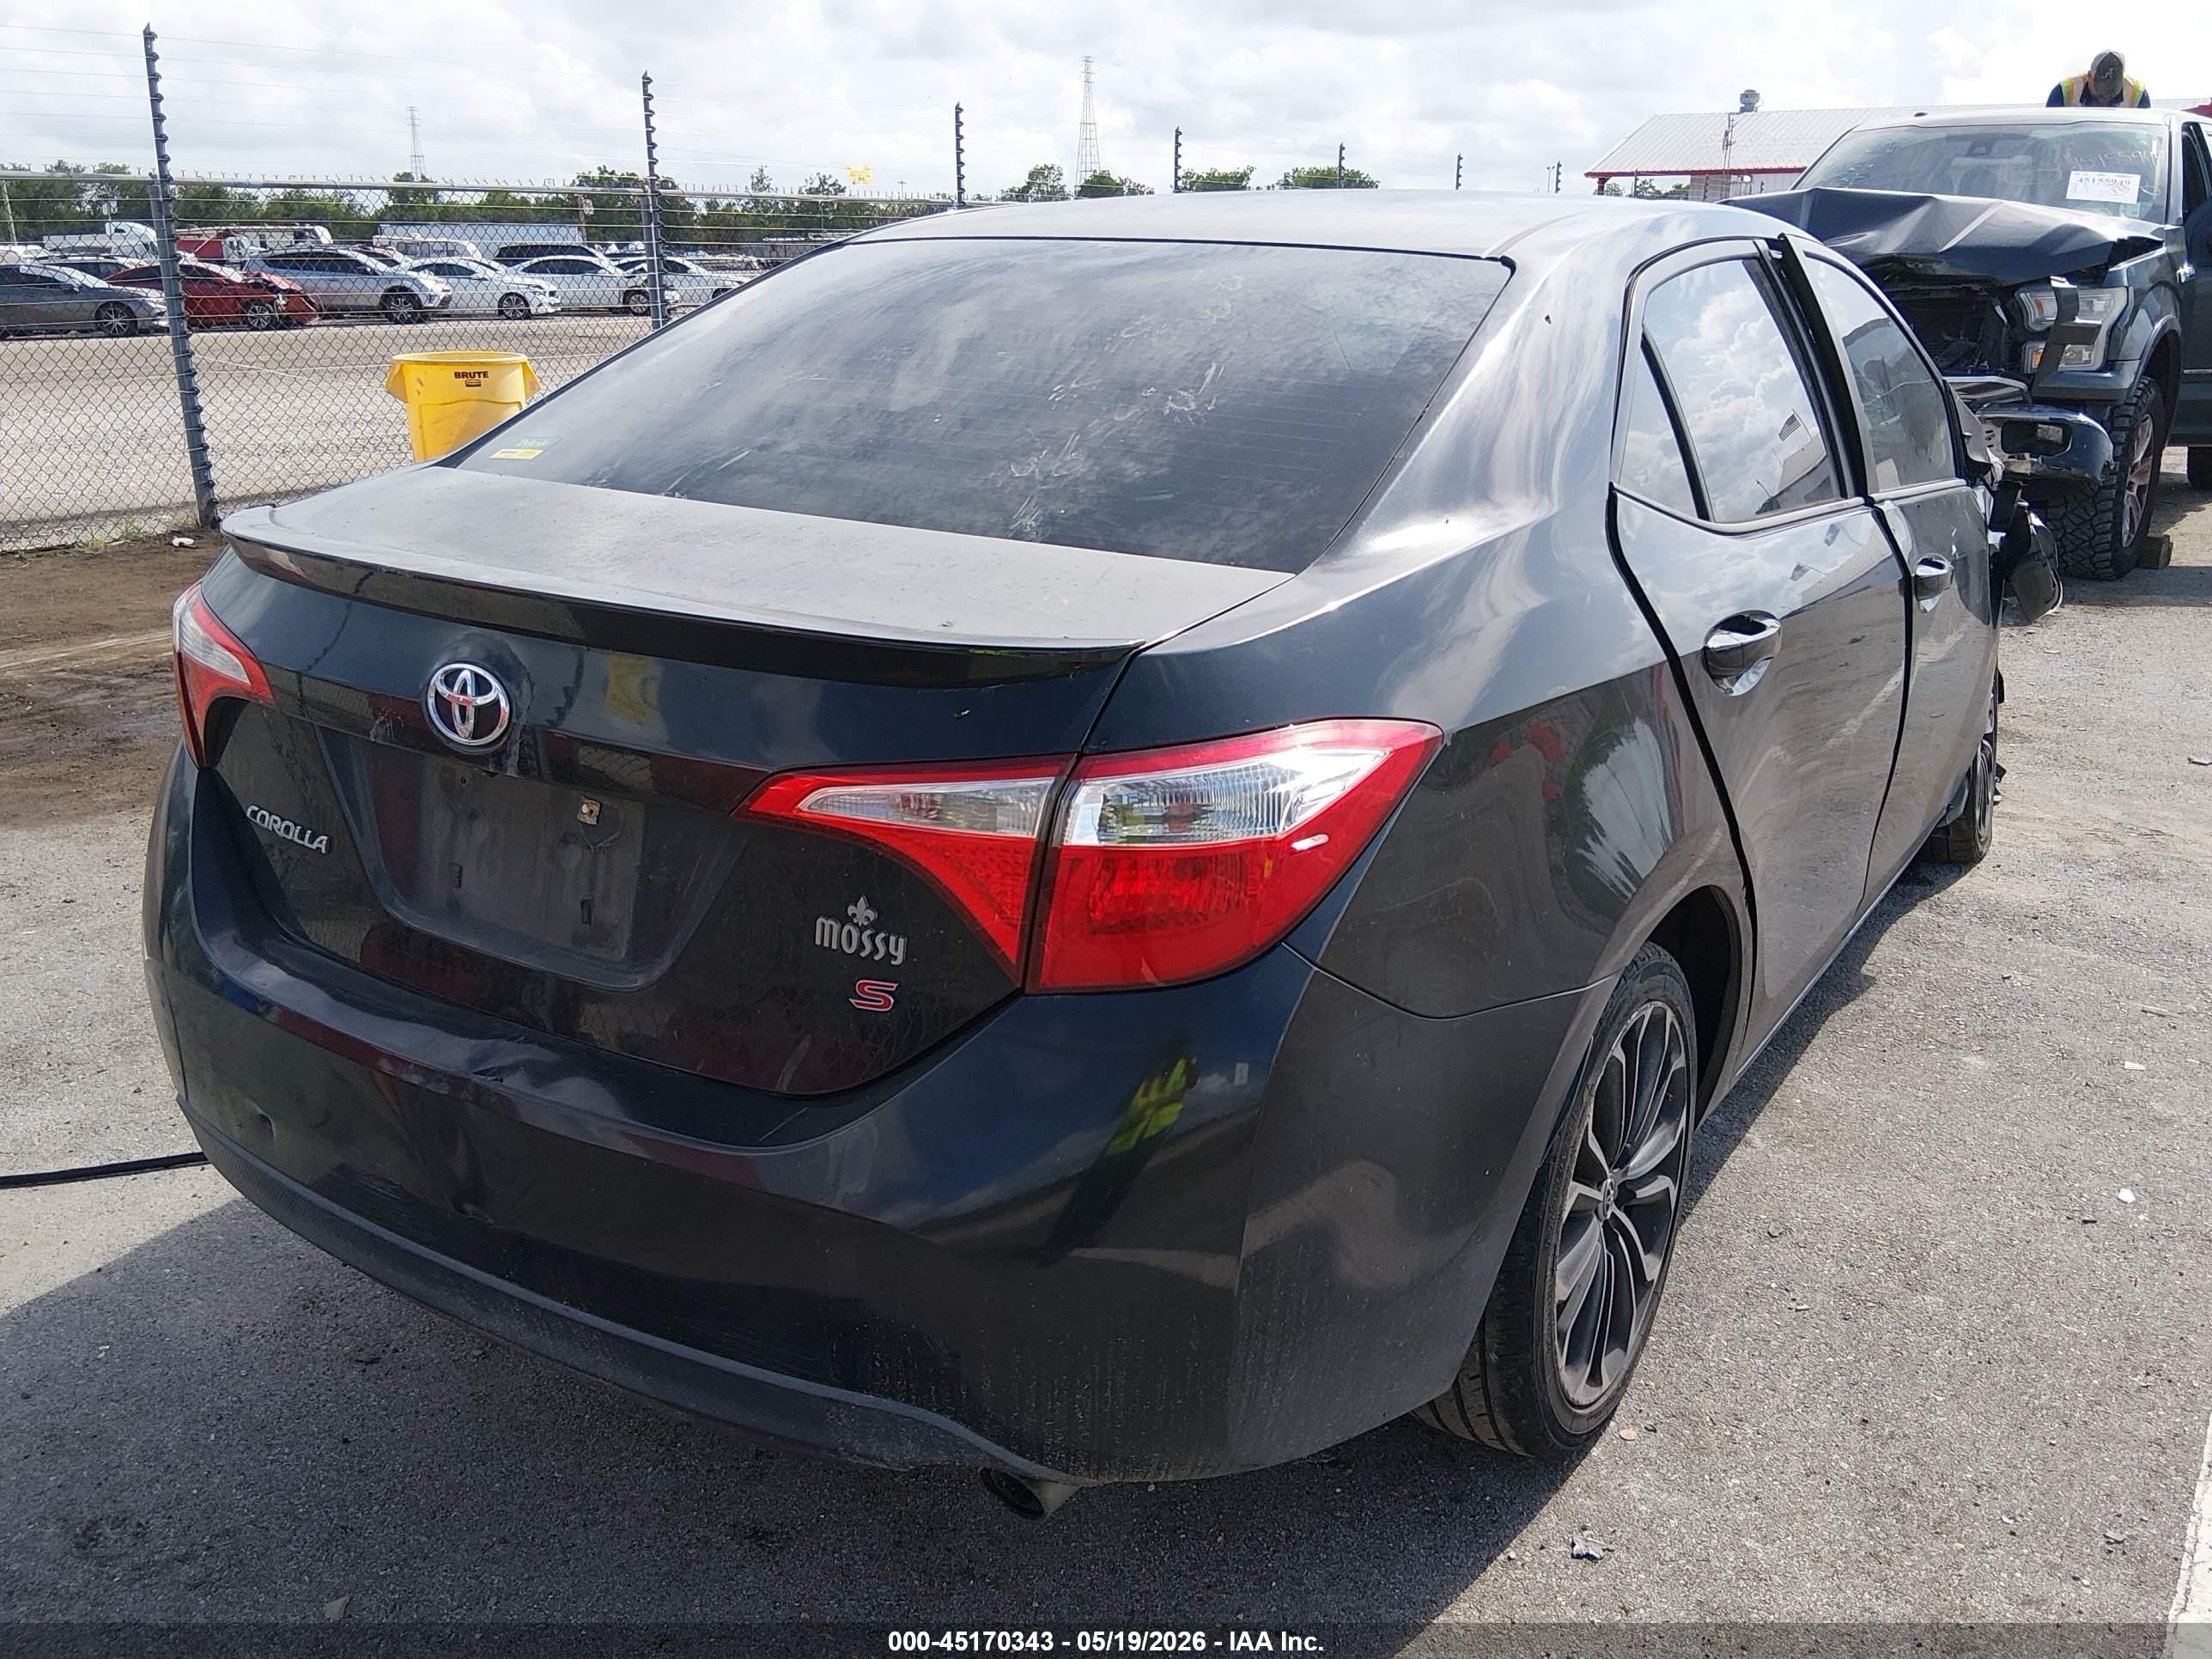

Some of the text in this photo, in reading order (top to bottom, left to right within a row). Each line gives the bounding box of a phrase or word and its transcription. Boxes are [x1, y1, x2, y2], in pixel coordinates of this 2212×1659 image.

[453, 370, 489, 380] BRUTE
[246, 805, 329, 854] COROLLA
[848, 979, 900, 1012] S
